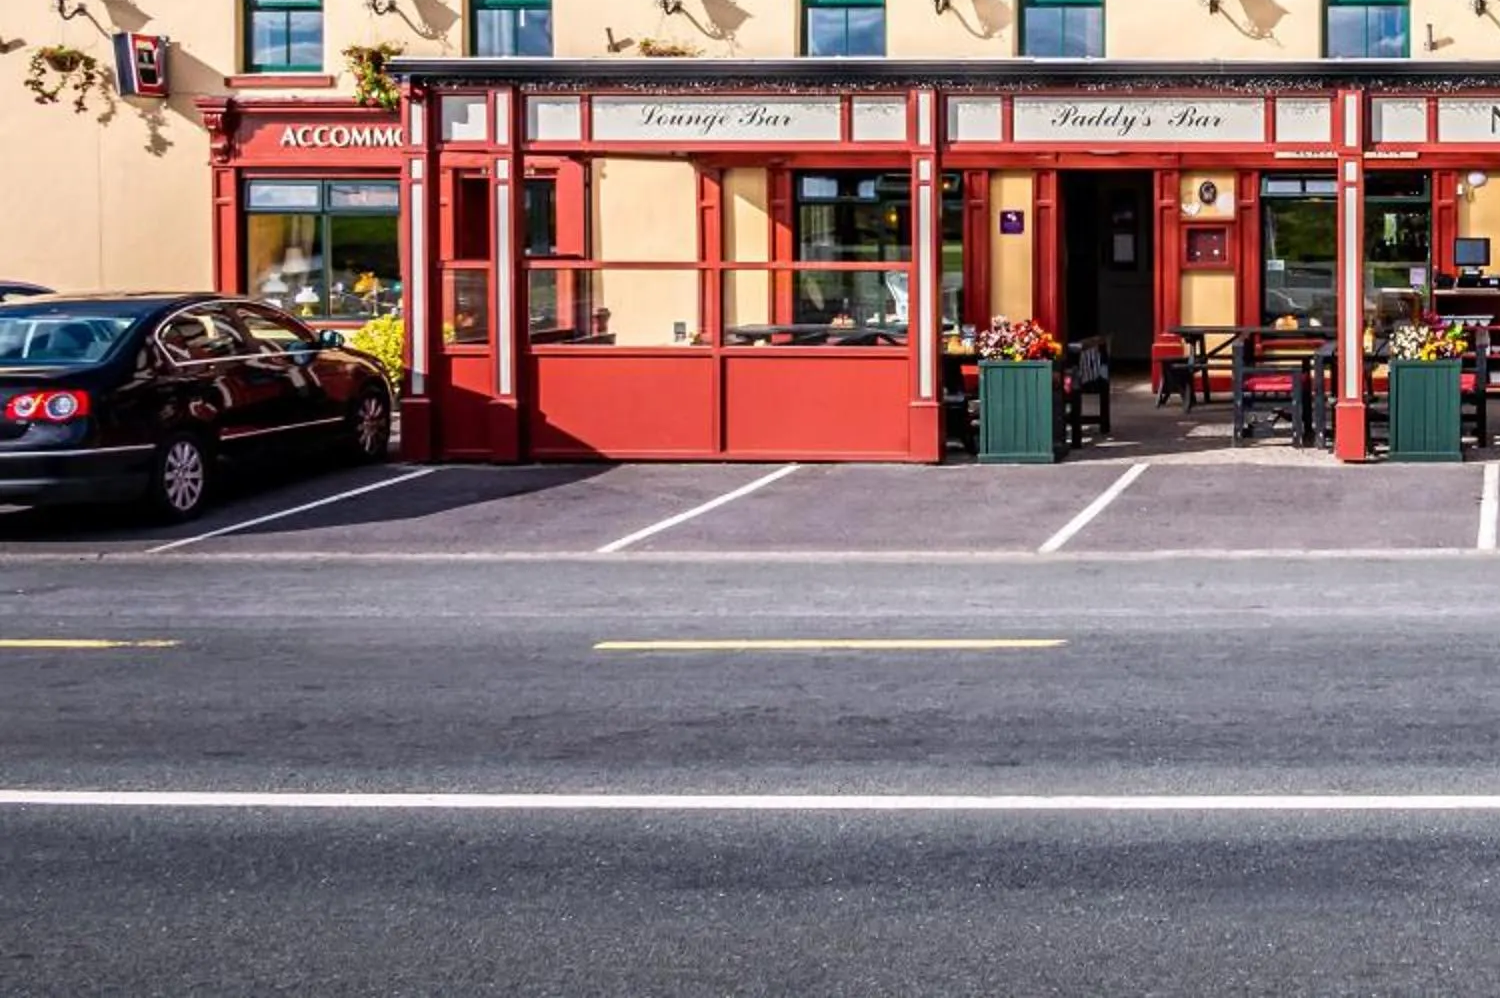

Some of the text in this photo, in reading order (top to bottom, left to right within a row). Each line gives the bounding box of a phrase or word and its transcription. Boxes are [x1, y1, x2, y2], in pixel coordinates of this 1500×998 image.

[640, 104, 793, 135] Lounge Bar
[1051, 105, 1226, 137] Paddy's Bar
